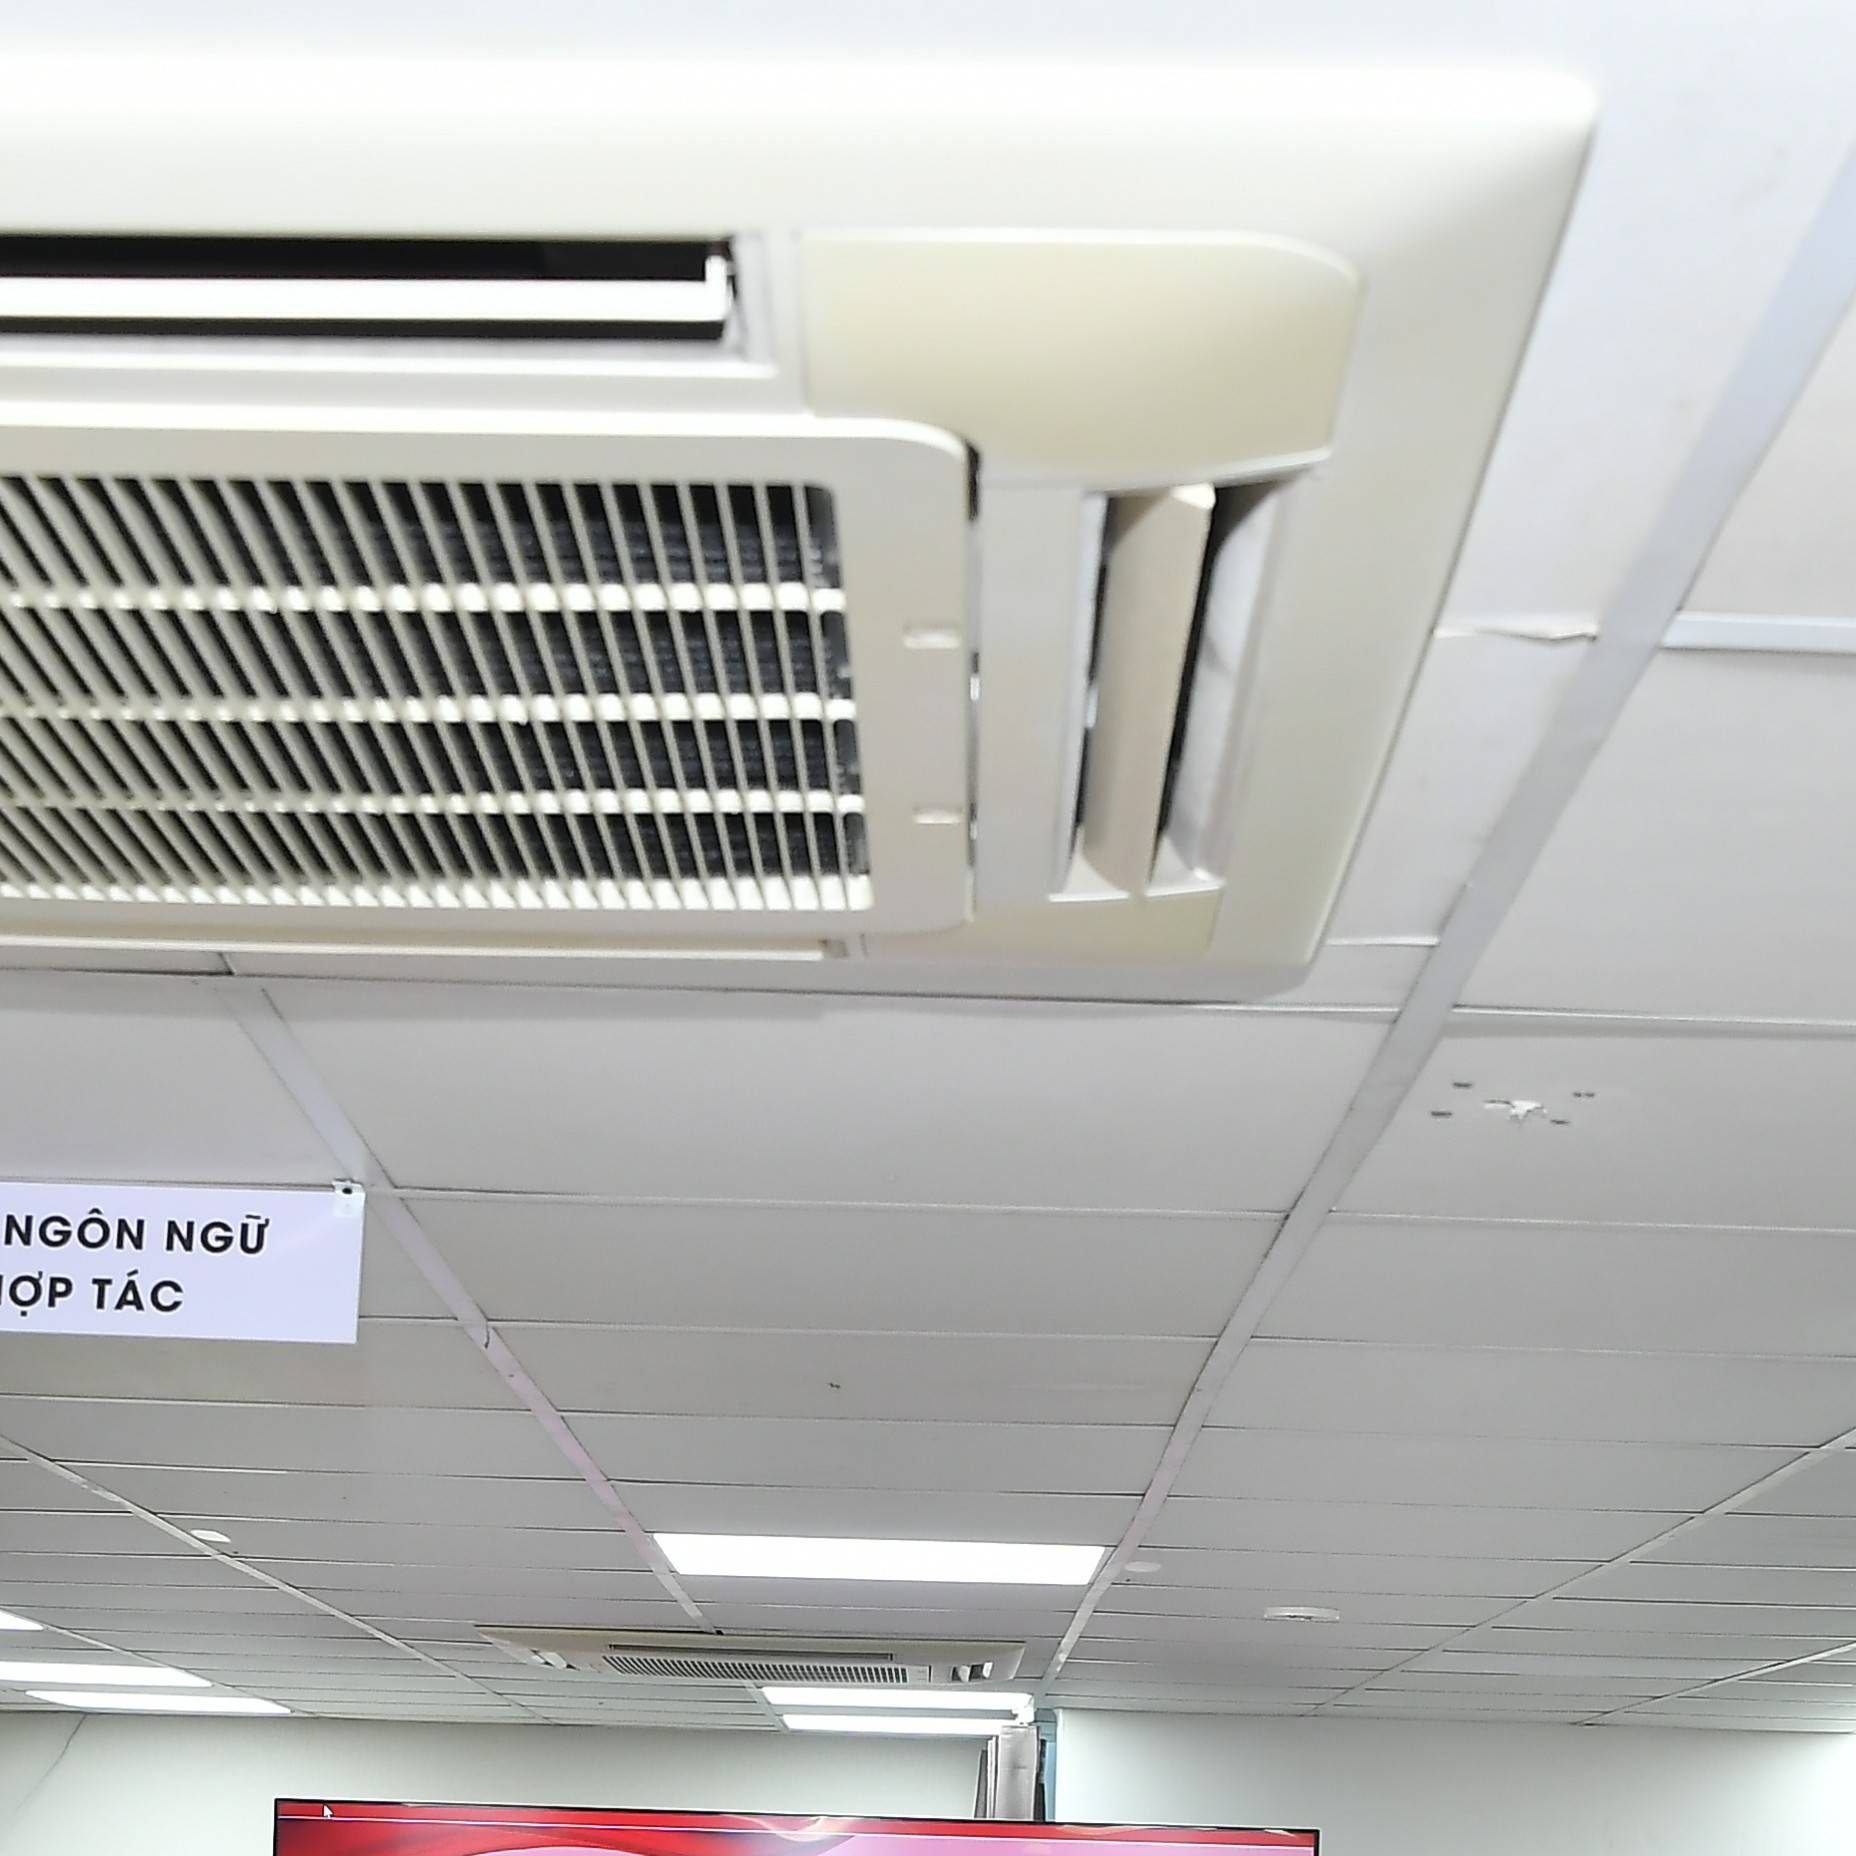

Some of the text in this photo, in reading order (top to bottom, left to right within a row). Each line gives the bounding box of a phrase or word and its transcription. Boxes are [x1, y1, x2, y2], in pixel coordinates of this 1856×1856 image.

[4, 1206, 145, 1252] NGÔN
[165, 1213, 271, 1256] NGỮ
[91, 1268, 185, 1312] TÁC
